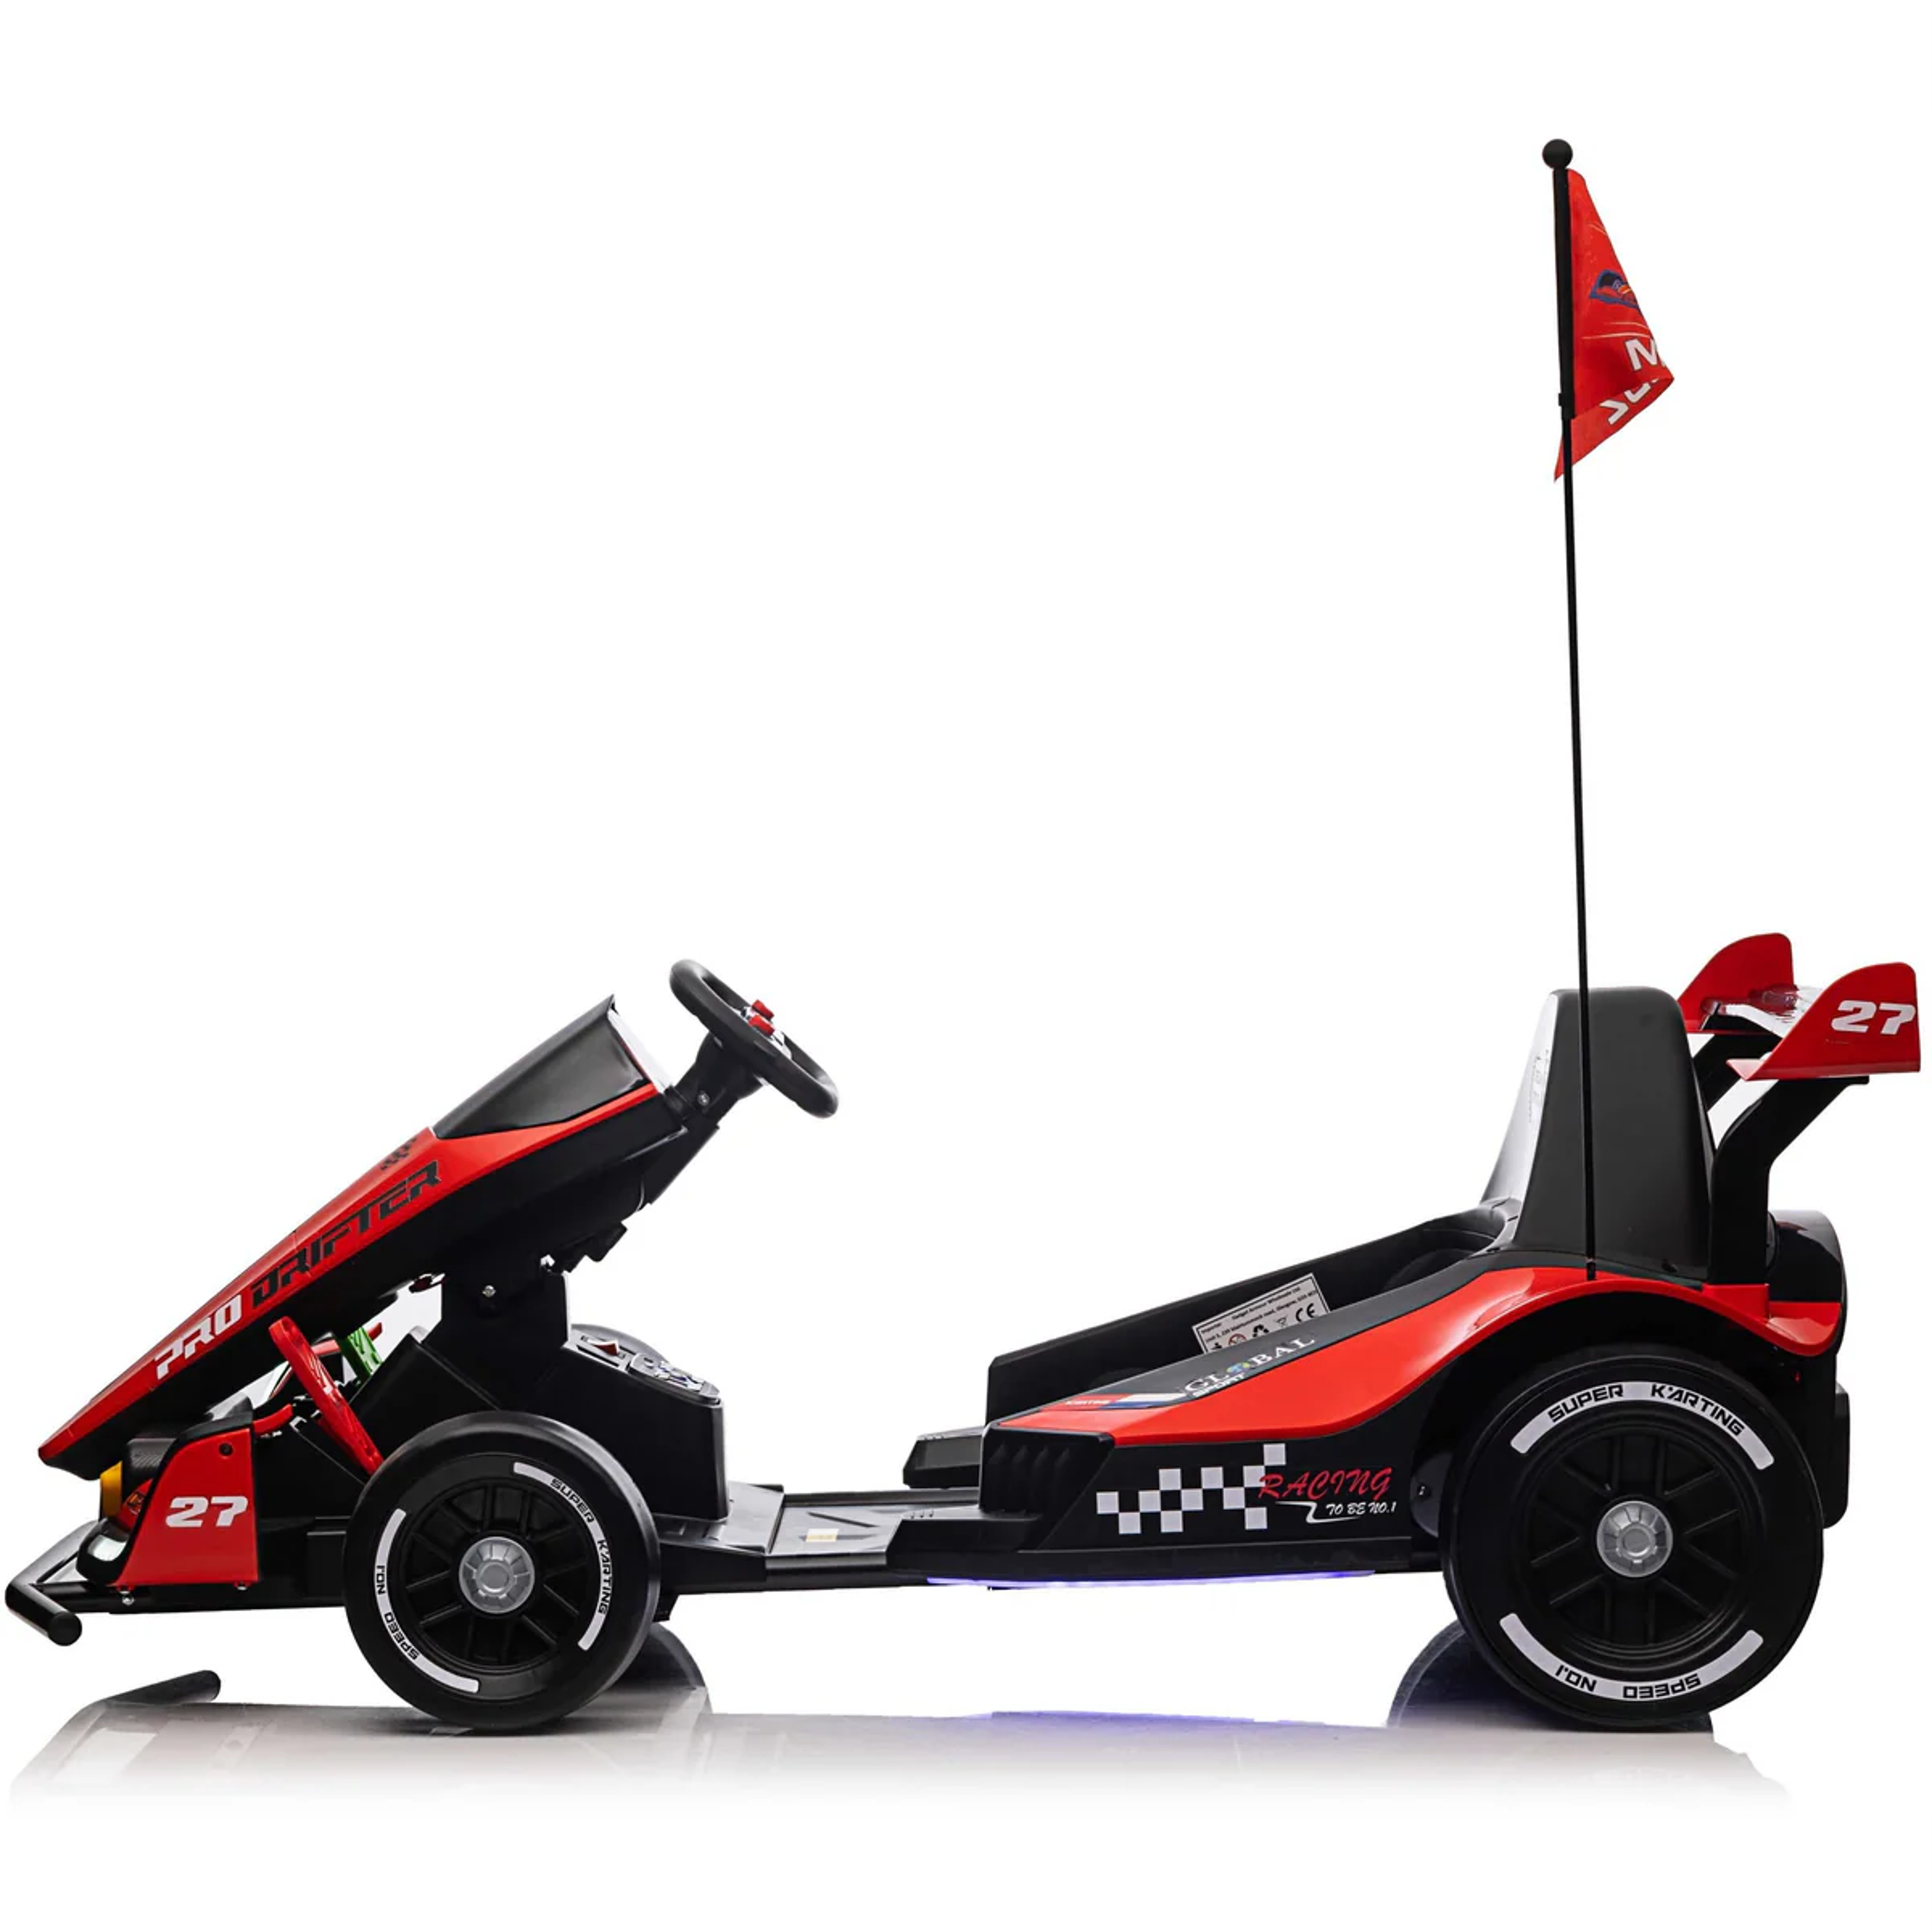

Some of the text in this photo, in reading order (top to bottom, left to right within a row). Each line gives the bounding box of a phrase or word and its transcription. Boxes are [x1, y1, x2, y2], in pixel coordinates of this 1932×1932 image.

[1831, 1000, 1916, 1035] 27
[153, 1160, 442, 1380] PRO DRIFTER
[1547, 1384, 1624, 1422] SUPER
[550, 1478, 595, 1524] SUPER
[1257, 1467, 1393, 1501] RACING
[165, 1496, 248, 1528] 27
[1326, 1501, 1397, 1515] TO BE NO.1
[384, 1612, 420, 1660] SPEED
[1555, 1664, 1702, 1699] SPEED NO.1
